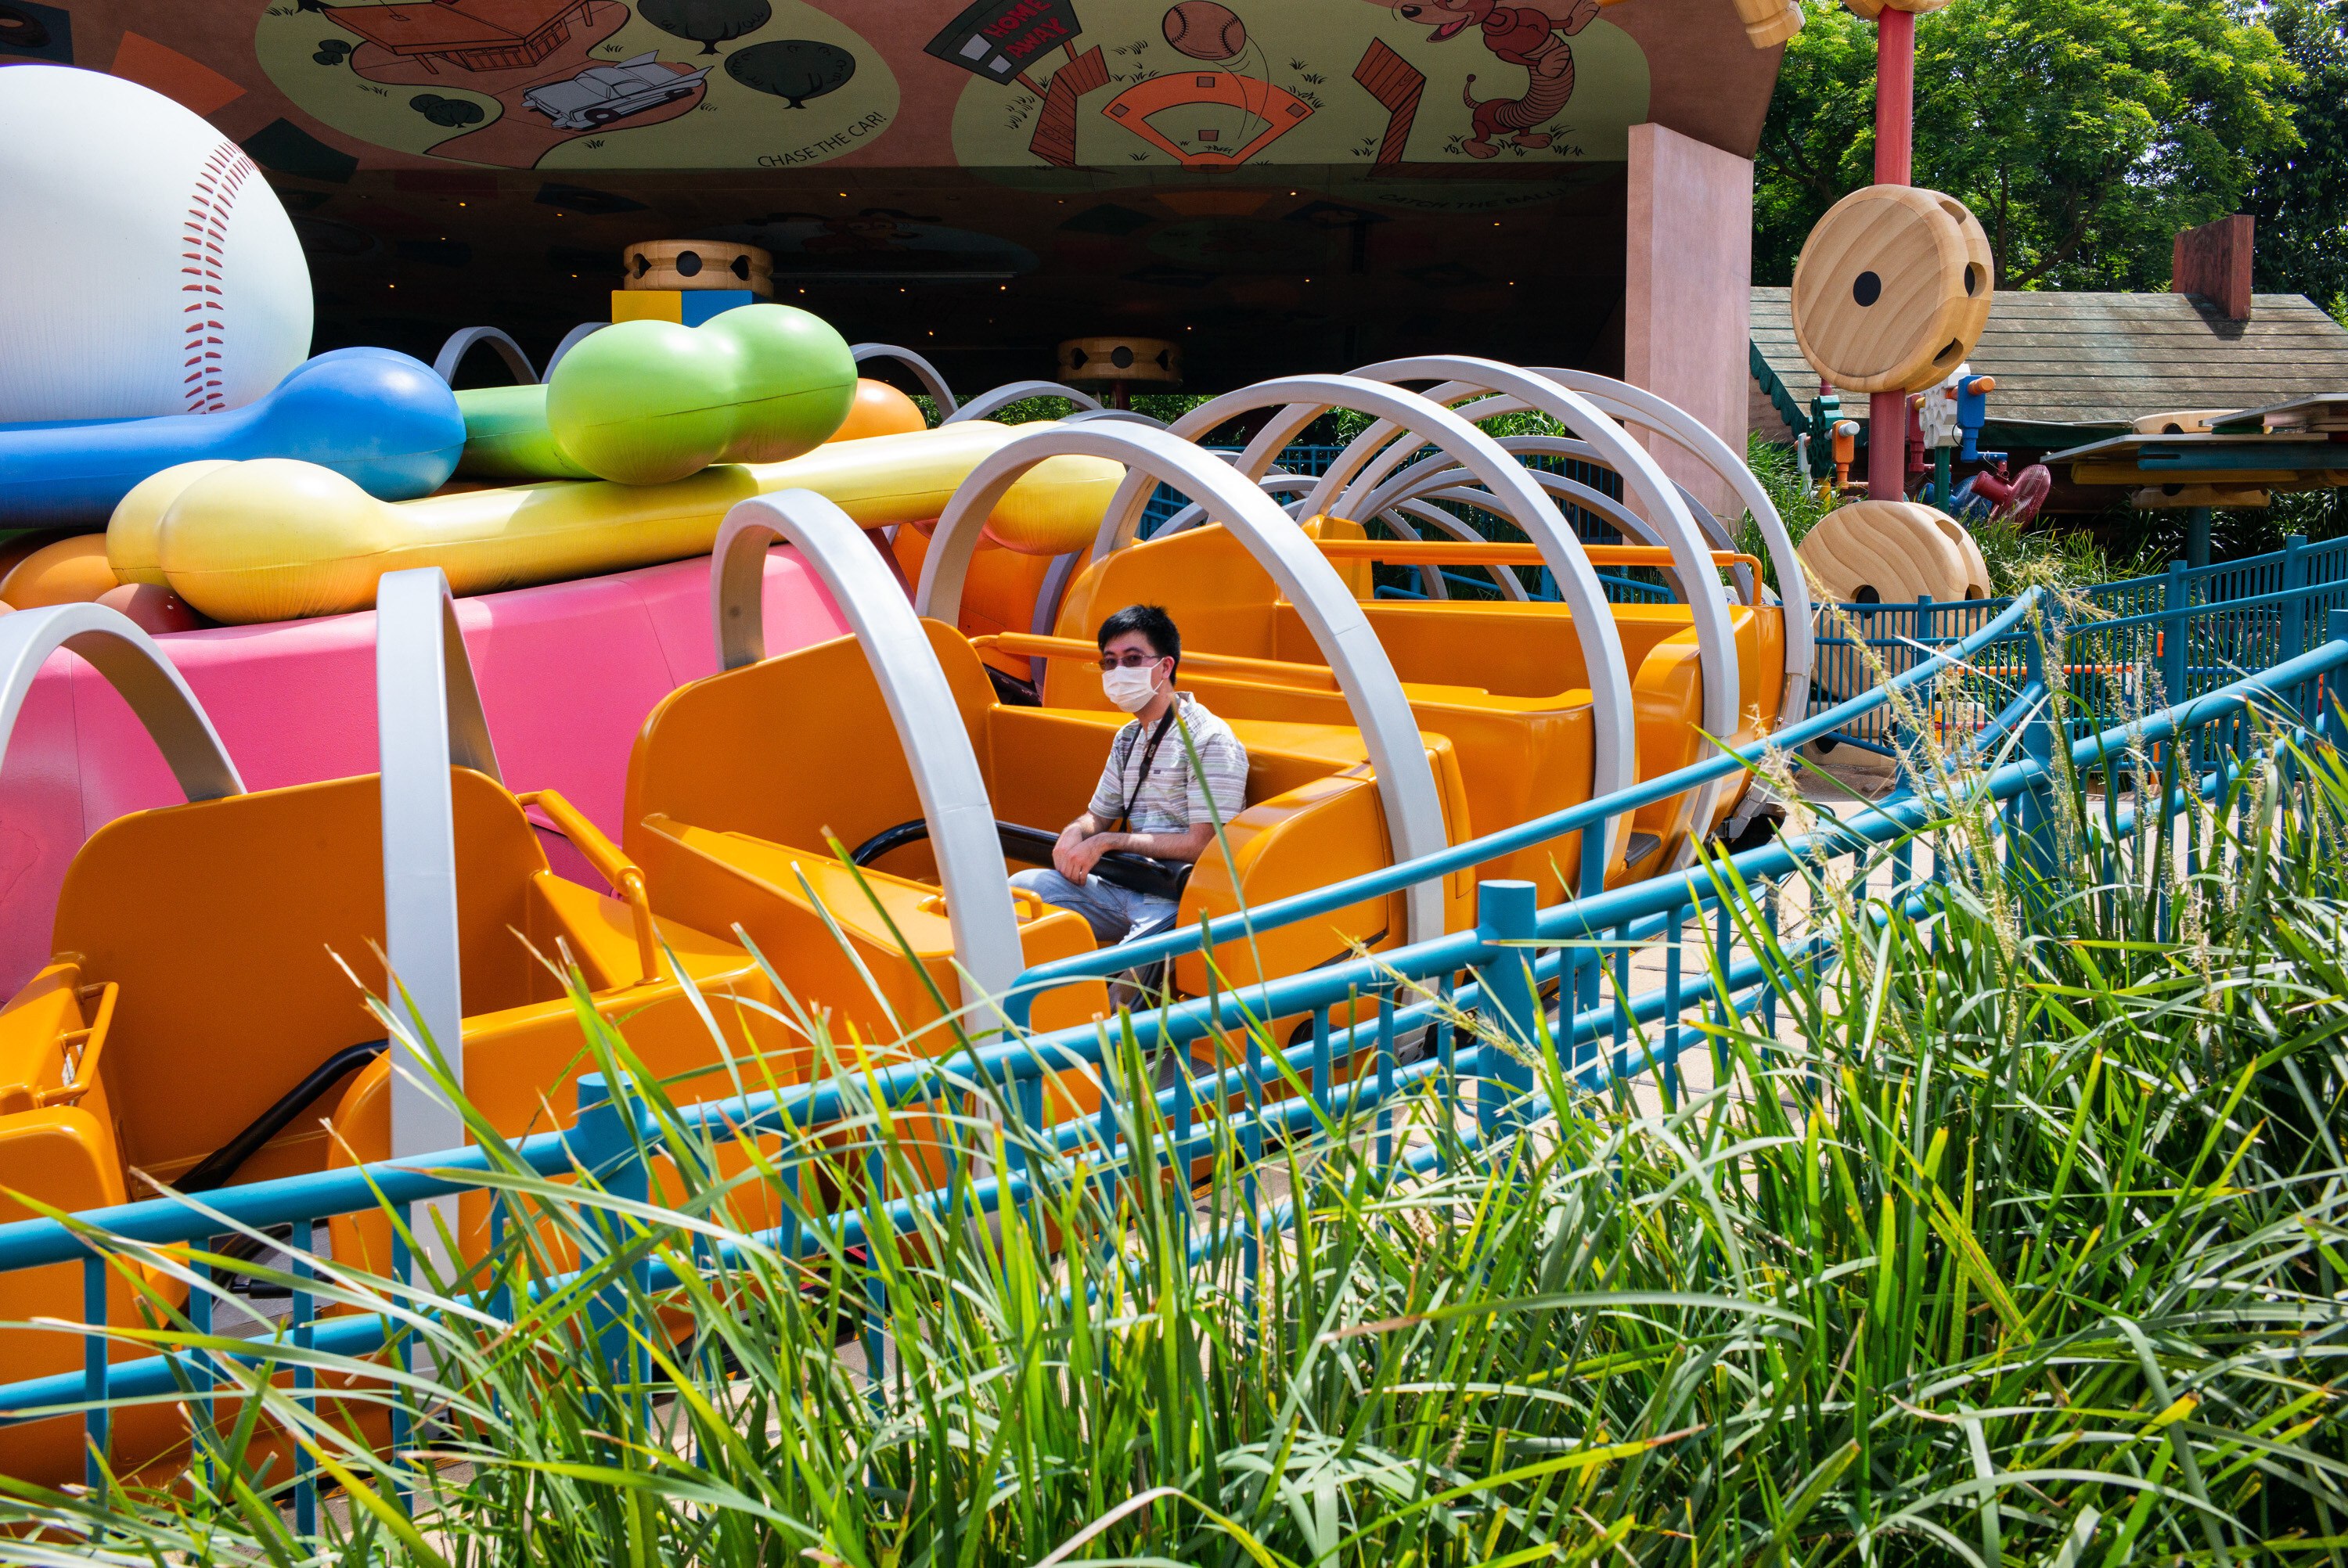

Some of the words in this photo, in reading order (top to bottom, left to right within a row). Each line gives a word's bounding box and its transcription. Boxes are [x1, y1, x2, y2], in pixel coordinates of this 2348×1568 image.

[982, 0, 1053, 38] HOME
[1004, 17, 1070, 59] AWAY
[758, 146, 817, 167] CHASE
[813, 132, 852, 154] THE
[848, 111, 887, 137] CAR!
[1378, 193, 1449, 209] CATCH
[1457, 200, 1499, 209] THE
[1147, 743, 1157, 758] EOS
